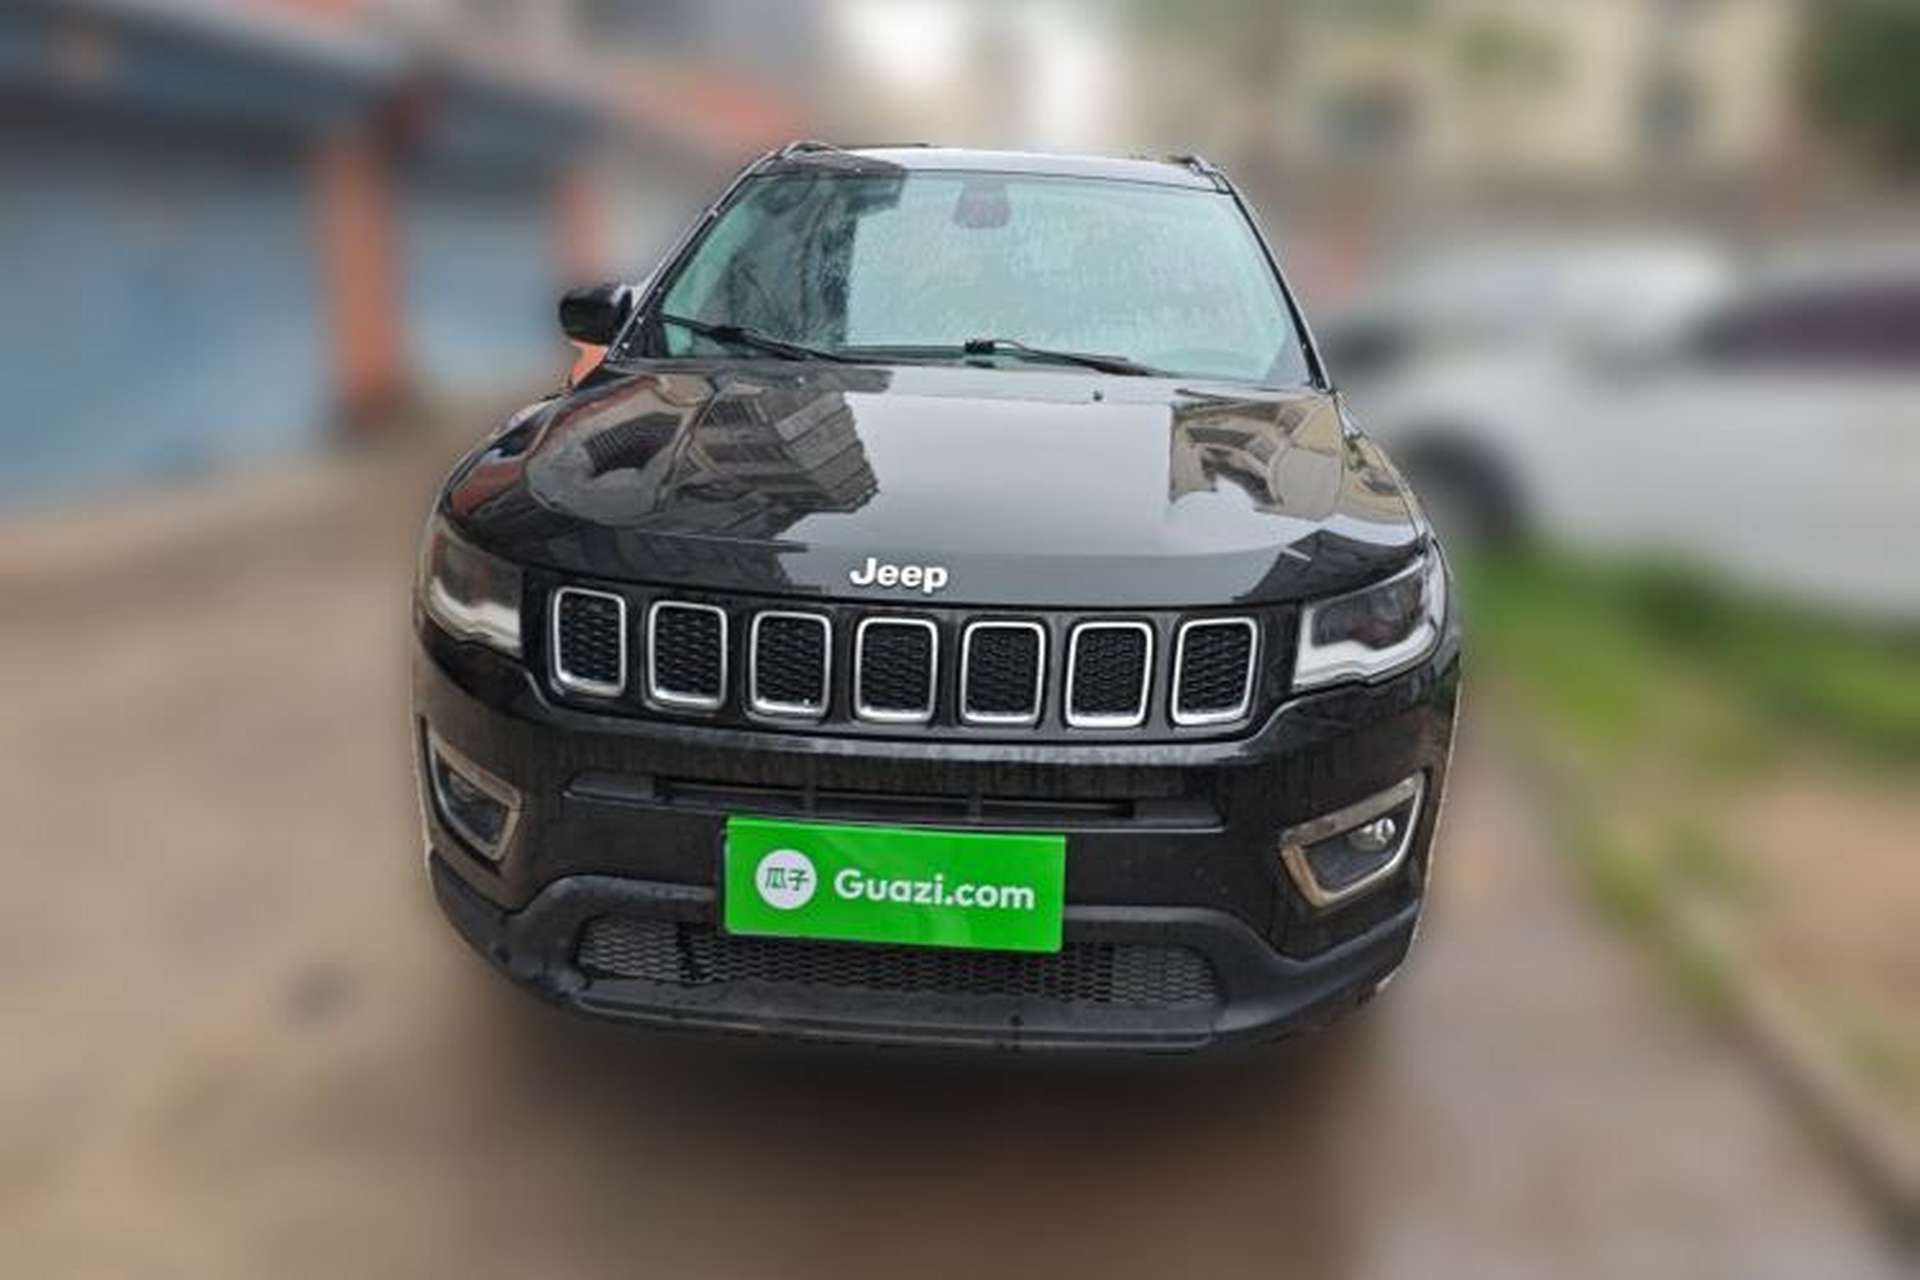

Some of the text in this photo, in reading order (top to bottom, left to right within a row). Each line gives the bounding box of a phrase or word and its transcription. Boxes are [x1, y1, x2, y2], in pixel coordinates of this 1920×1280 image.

[849, 556, 949, 594] Jeep
[764, 866, 809, 892] 瓜子
[833, 868, 1035, 910] Guazi.com
